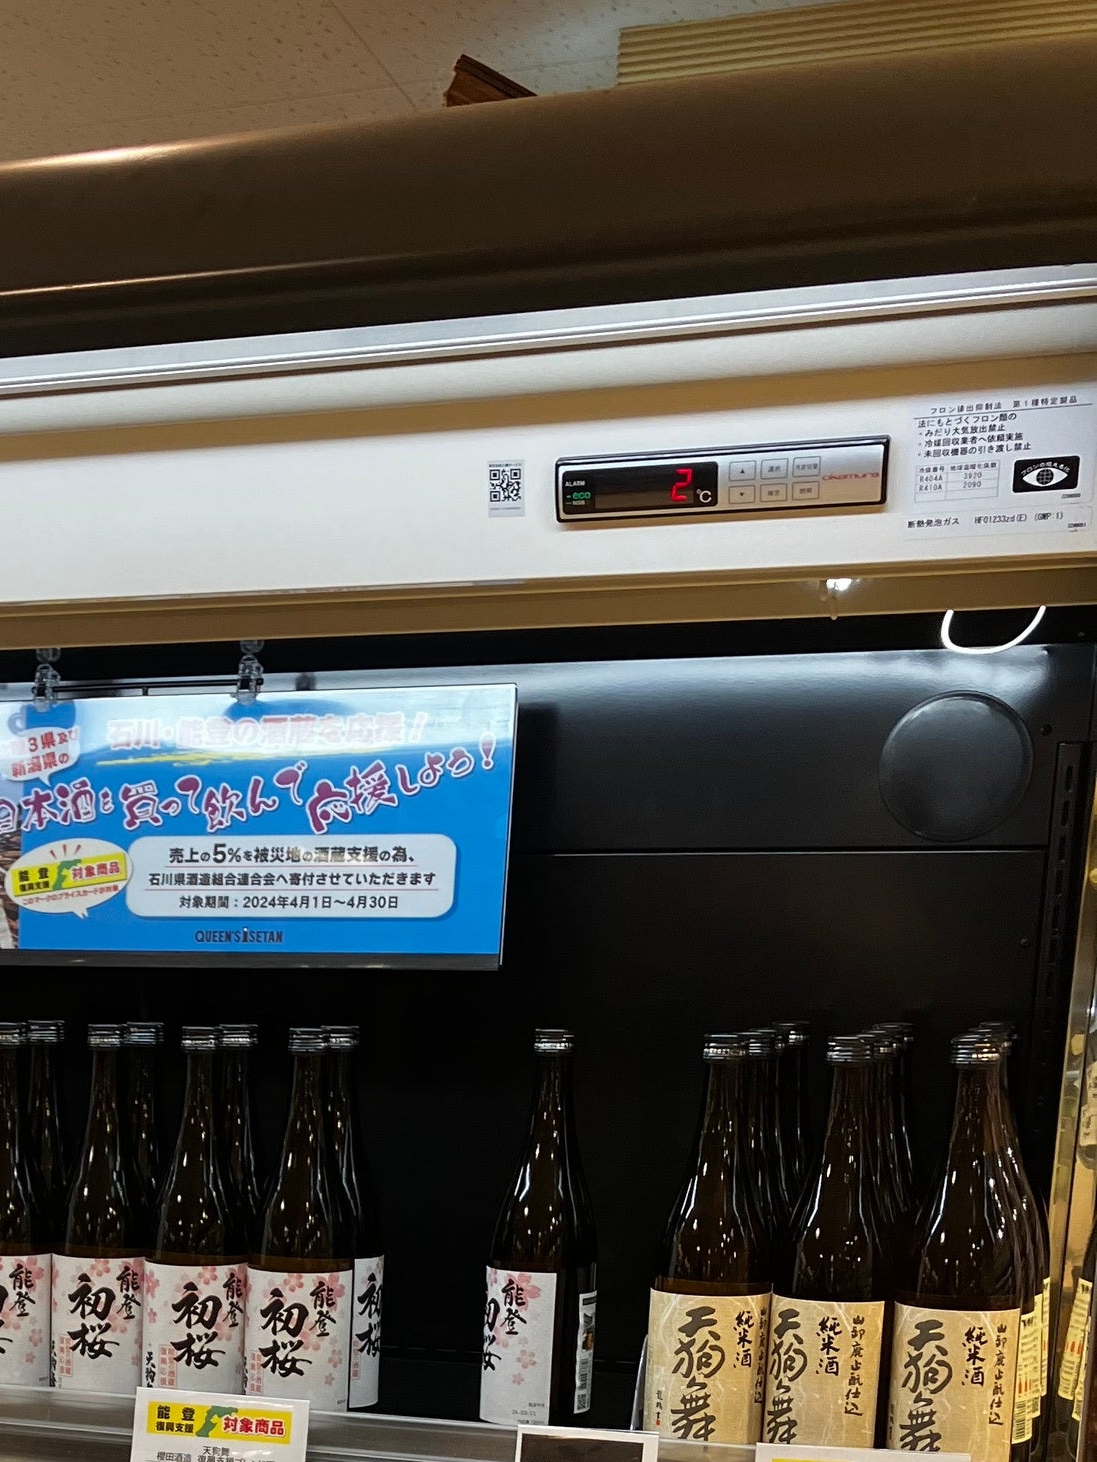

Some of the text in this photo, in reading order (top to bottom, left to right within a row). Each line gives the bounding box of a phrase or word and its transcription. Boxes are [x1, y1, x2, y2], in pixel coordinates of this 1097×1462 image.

[918, 413, 1017, 428] 法にもとづくフロン類の
[672, 468, 693, 502] 2
[572, 491, 591, 500] eco
[907, 517, 960, 528] 断熱発泡ガス
[19, 868, 50, 882] 能登
[71, 861, 121, 880] 対象商品
[500, 1278, 528, 1335] 能登
[732, 1310, 753, 1368] 純米酒
[815, 1316, 843, 1376] 純米酒
[961, 1326, 988, 1387] 純米酒
[223, 1416, 286, 1436] 対象商品
